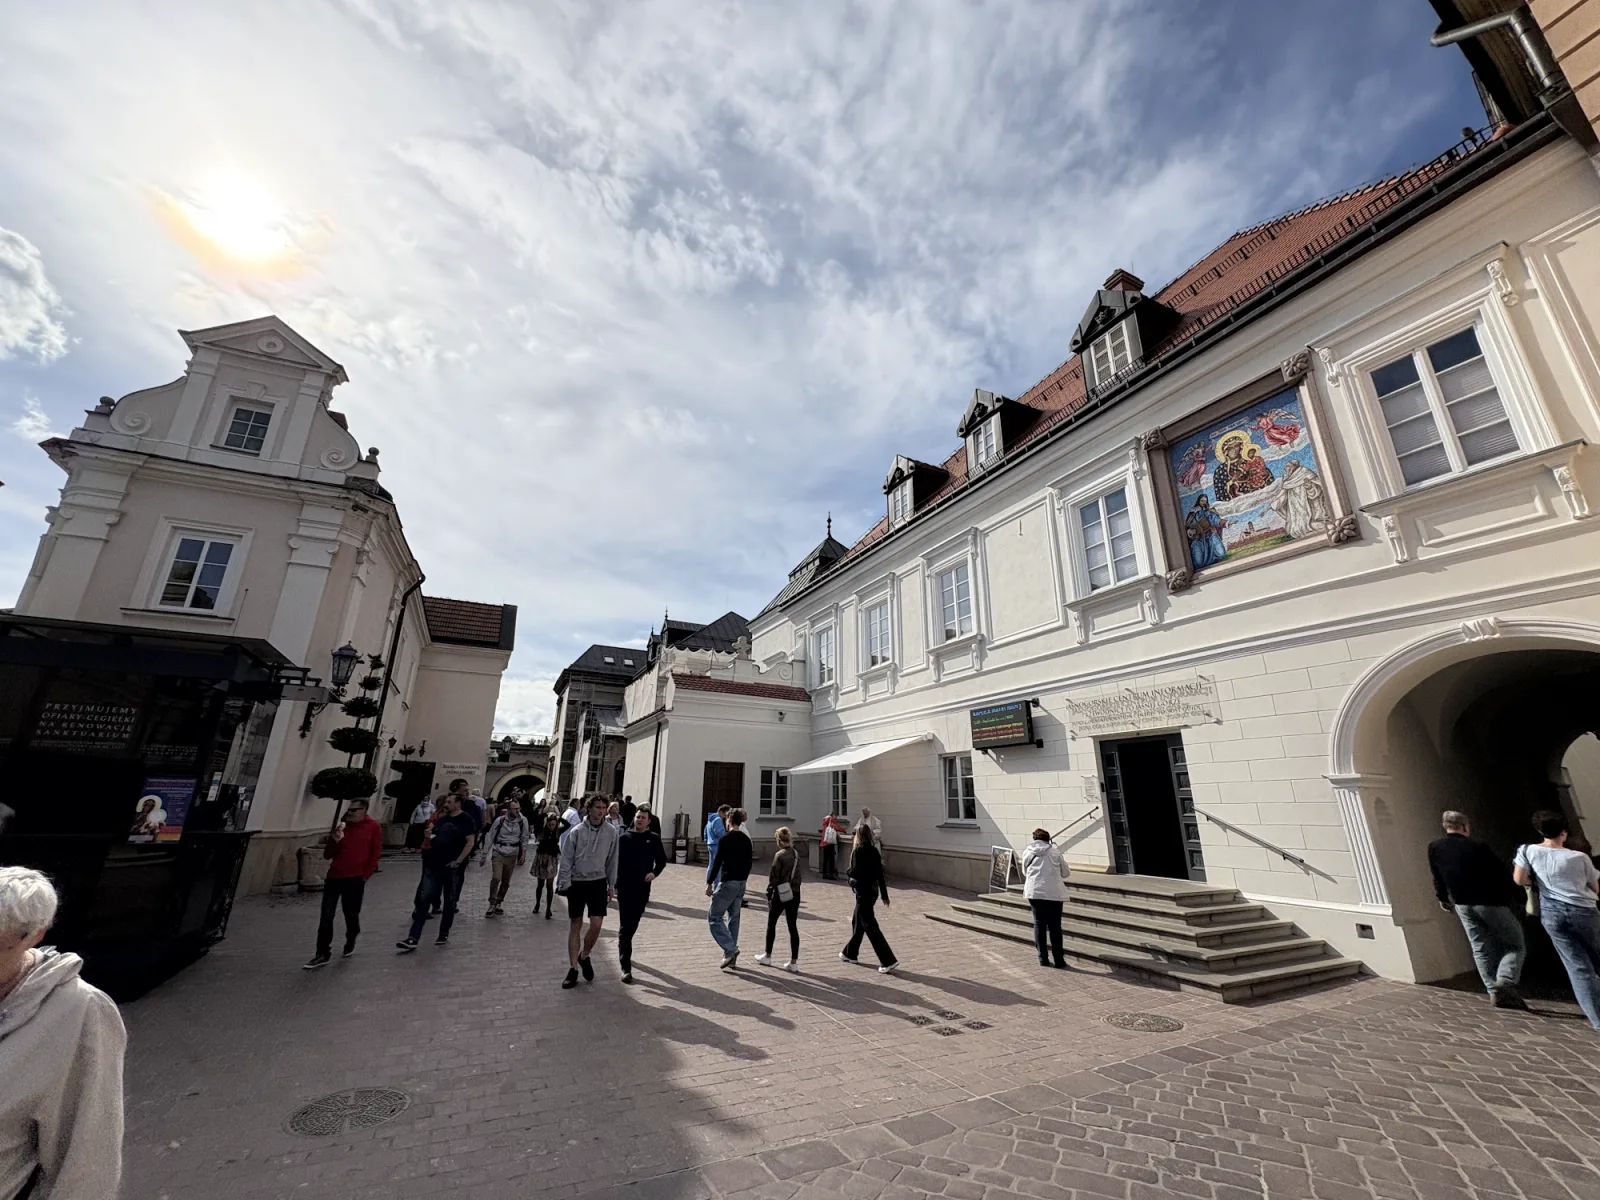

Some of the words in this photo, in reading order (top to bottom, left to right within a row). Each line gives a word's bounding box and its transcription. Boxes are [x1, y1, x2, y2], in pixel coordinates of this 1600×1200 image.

[1113, 690, 1148, 703] CENTRUM
[1150, 681, 1202, 698] INFORMACJI
[45, 703, 138, 715] PRZYJMUJEMY
[35, 729, 130, 739] SANKTUARIUM
